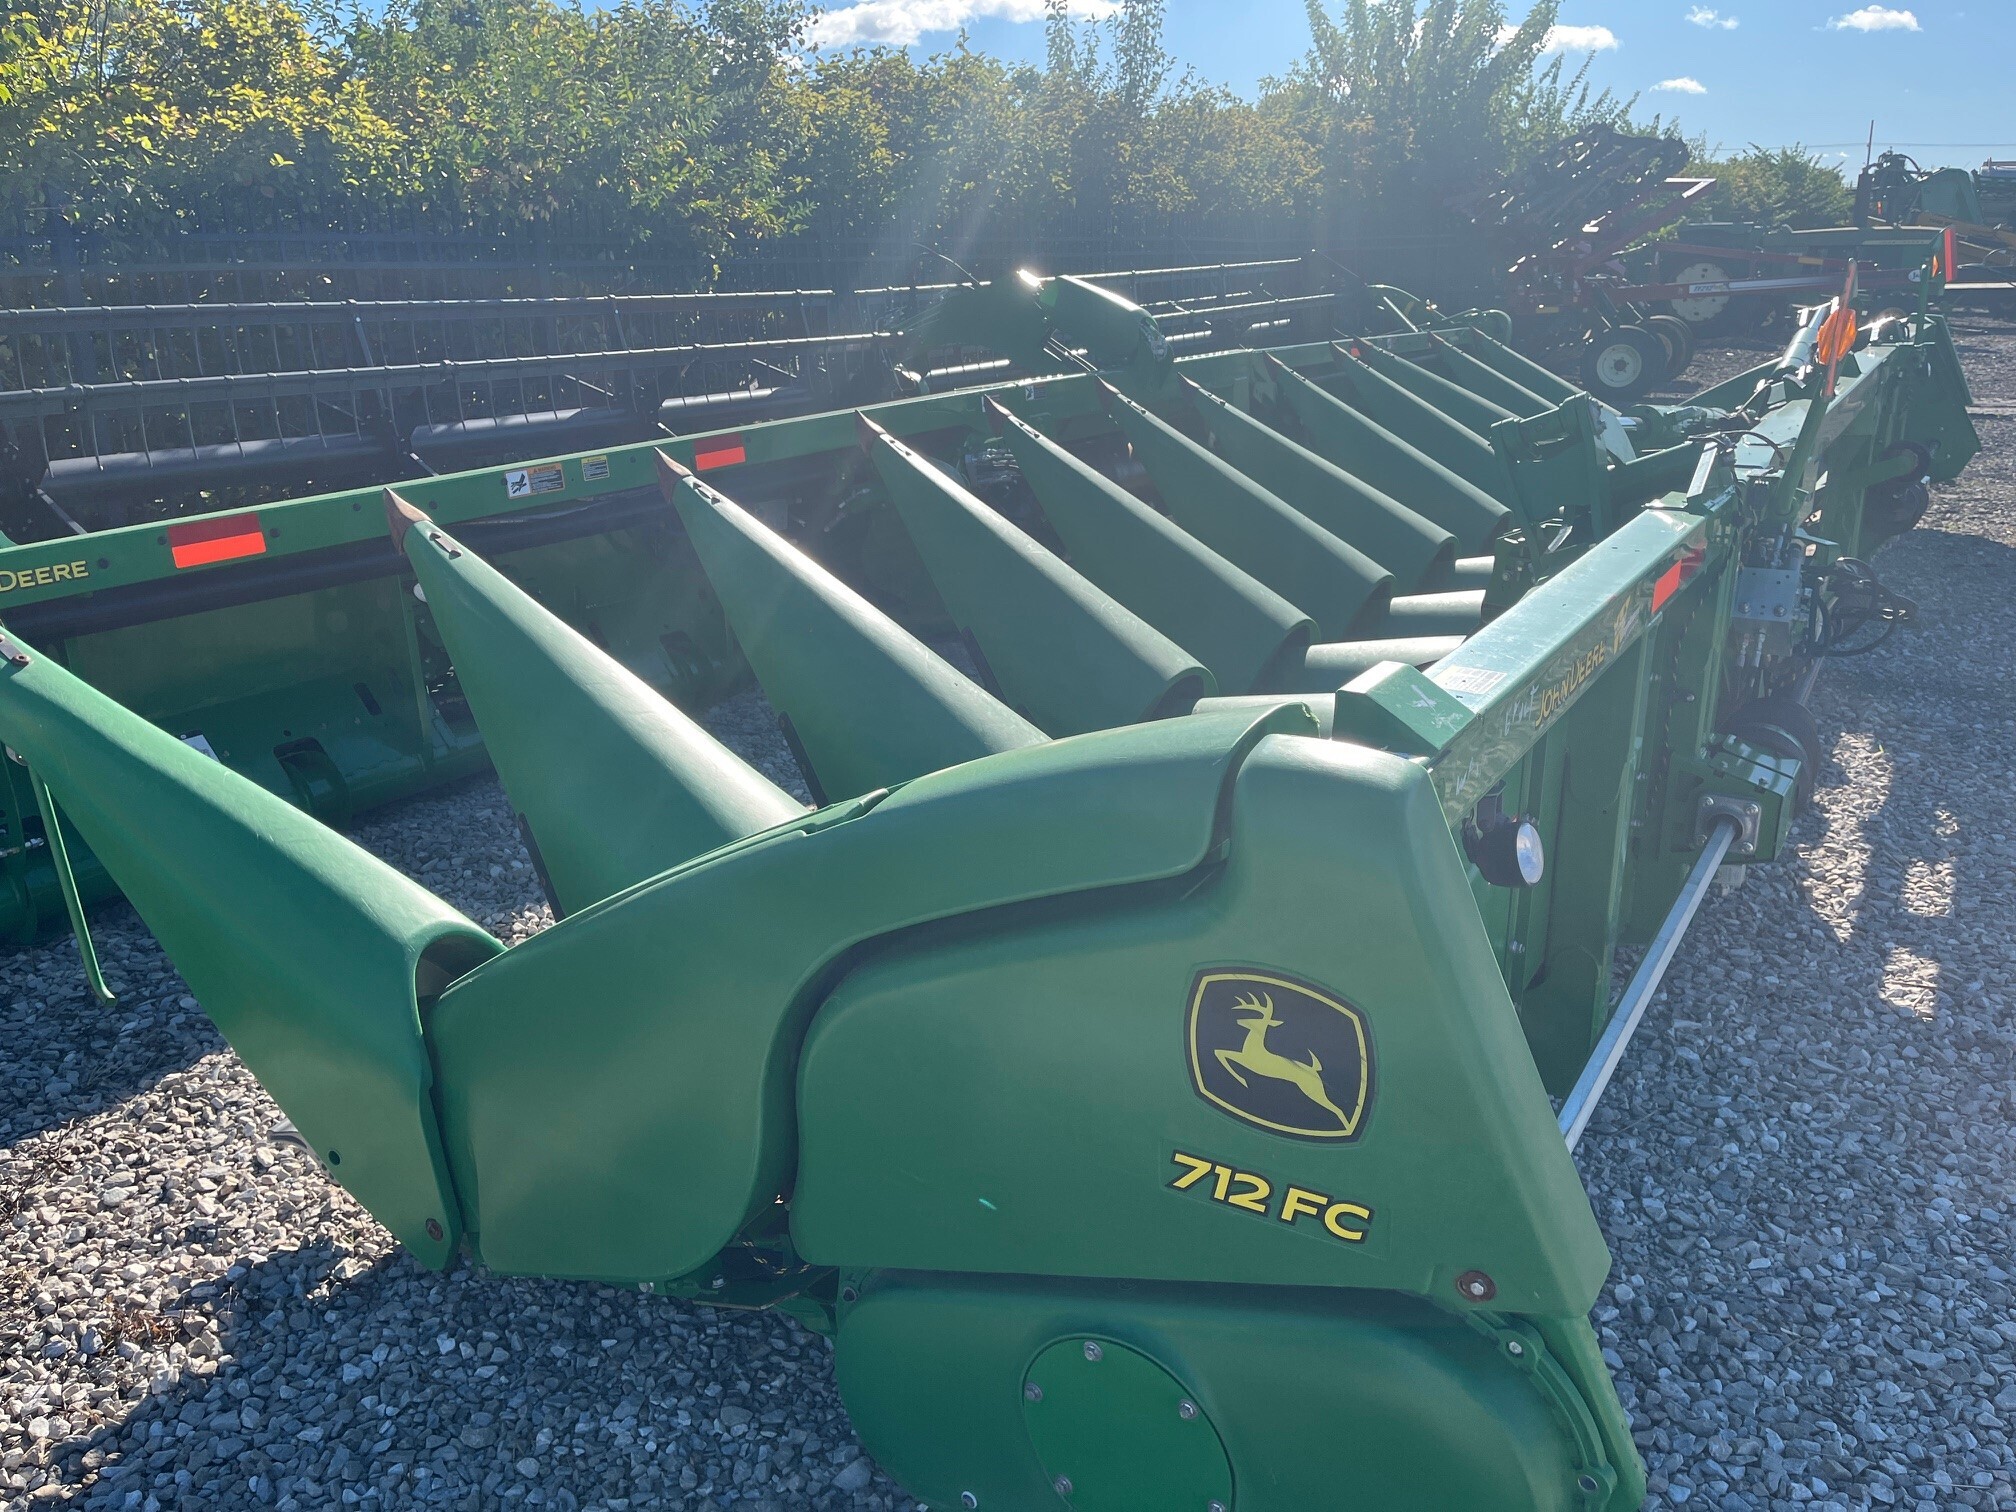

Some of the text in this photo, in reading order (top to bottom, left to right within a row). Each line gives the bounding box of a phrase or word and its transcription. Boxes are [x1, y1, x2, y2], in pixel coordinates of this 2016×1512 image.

[0, 560, 89, 592] DEERE
[1535, 671, 1570, 729] JOHN
[1570, 640, 1606, 693] DEERE
[1170, 1151, 1373, 1242] 712 FC
